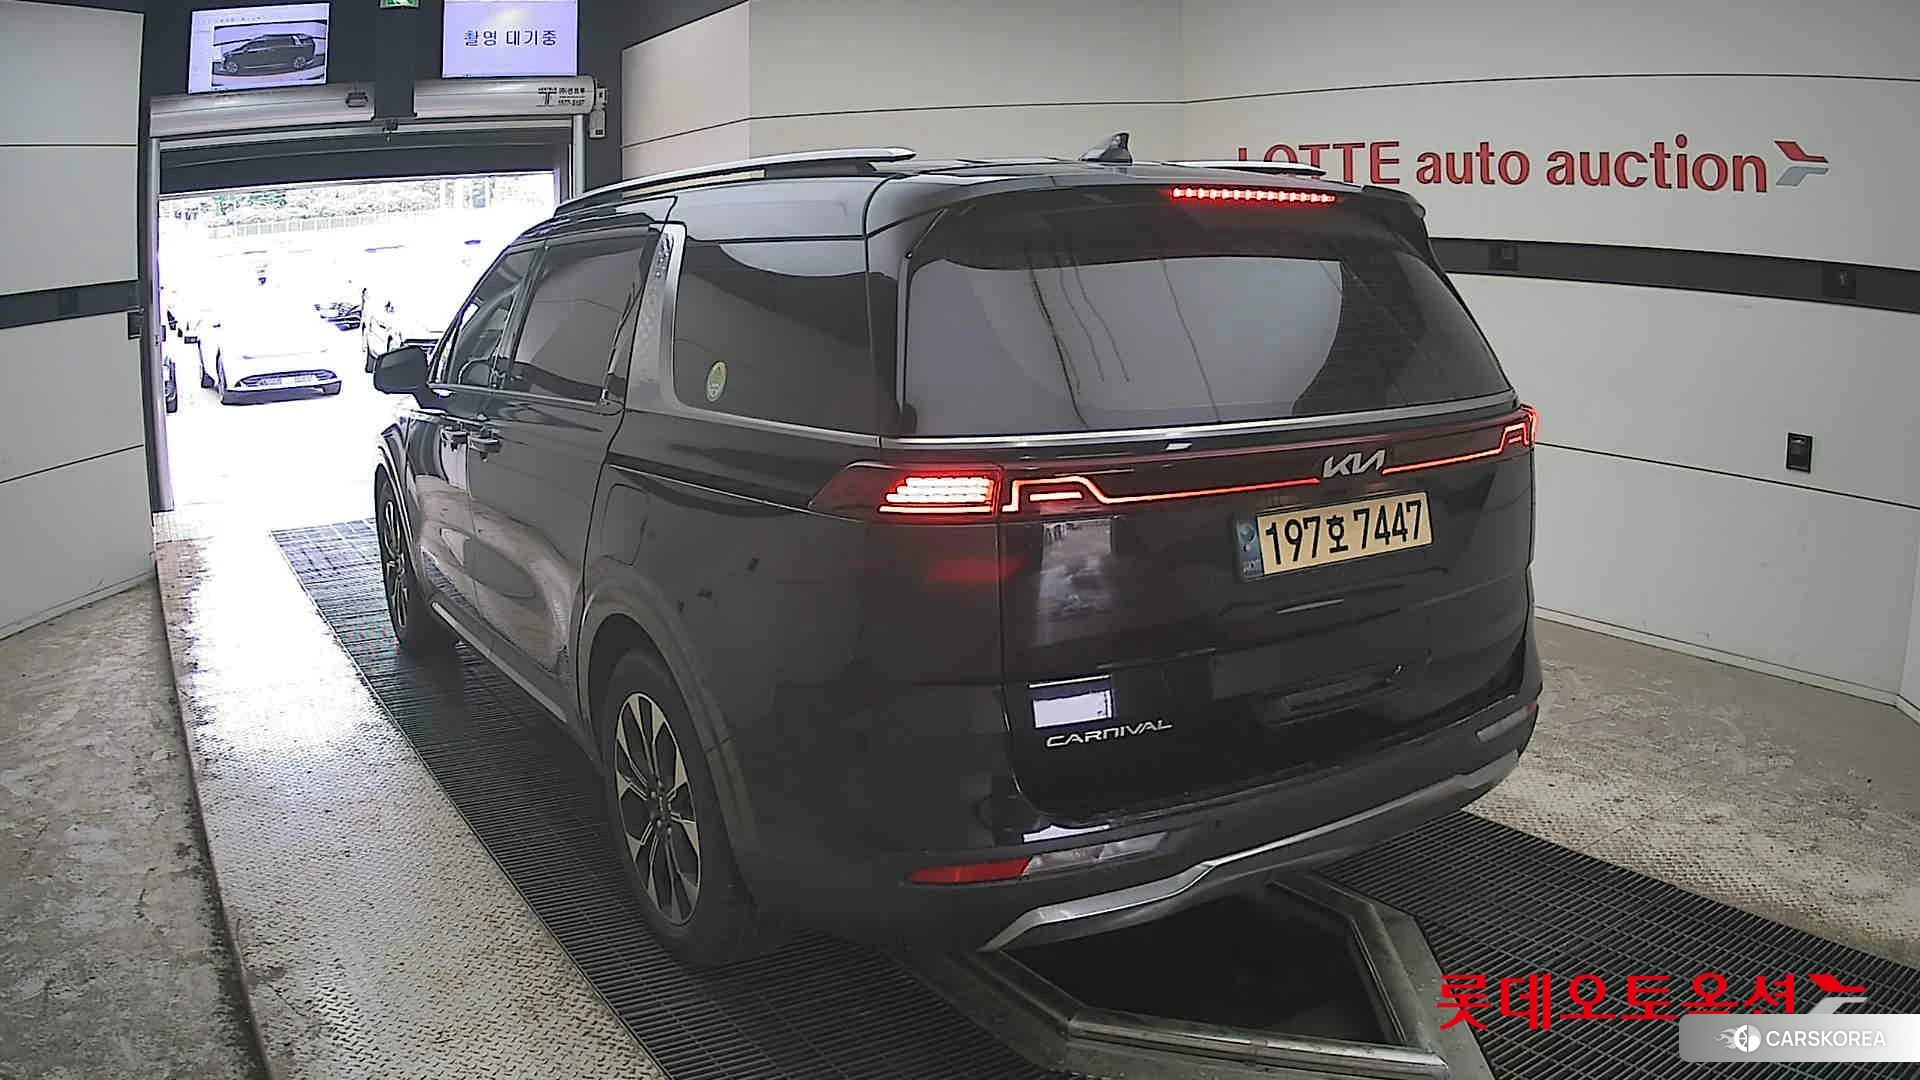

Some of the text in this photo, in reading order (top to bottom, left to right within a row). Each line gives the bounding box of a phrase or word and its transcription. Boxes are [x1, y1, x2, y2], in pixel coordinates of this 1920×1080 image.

[464, 30, 557, 47] 촬영 대기중
[1415, 141, 1531, 186] auto
[1546, 133, 1768, 194] auction
[1046, 719, 1173, 747] CARNIVAL
